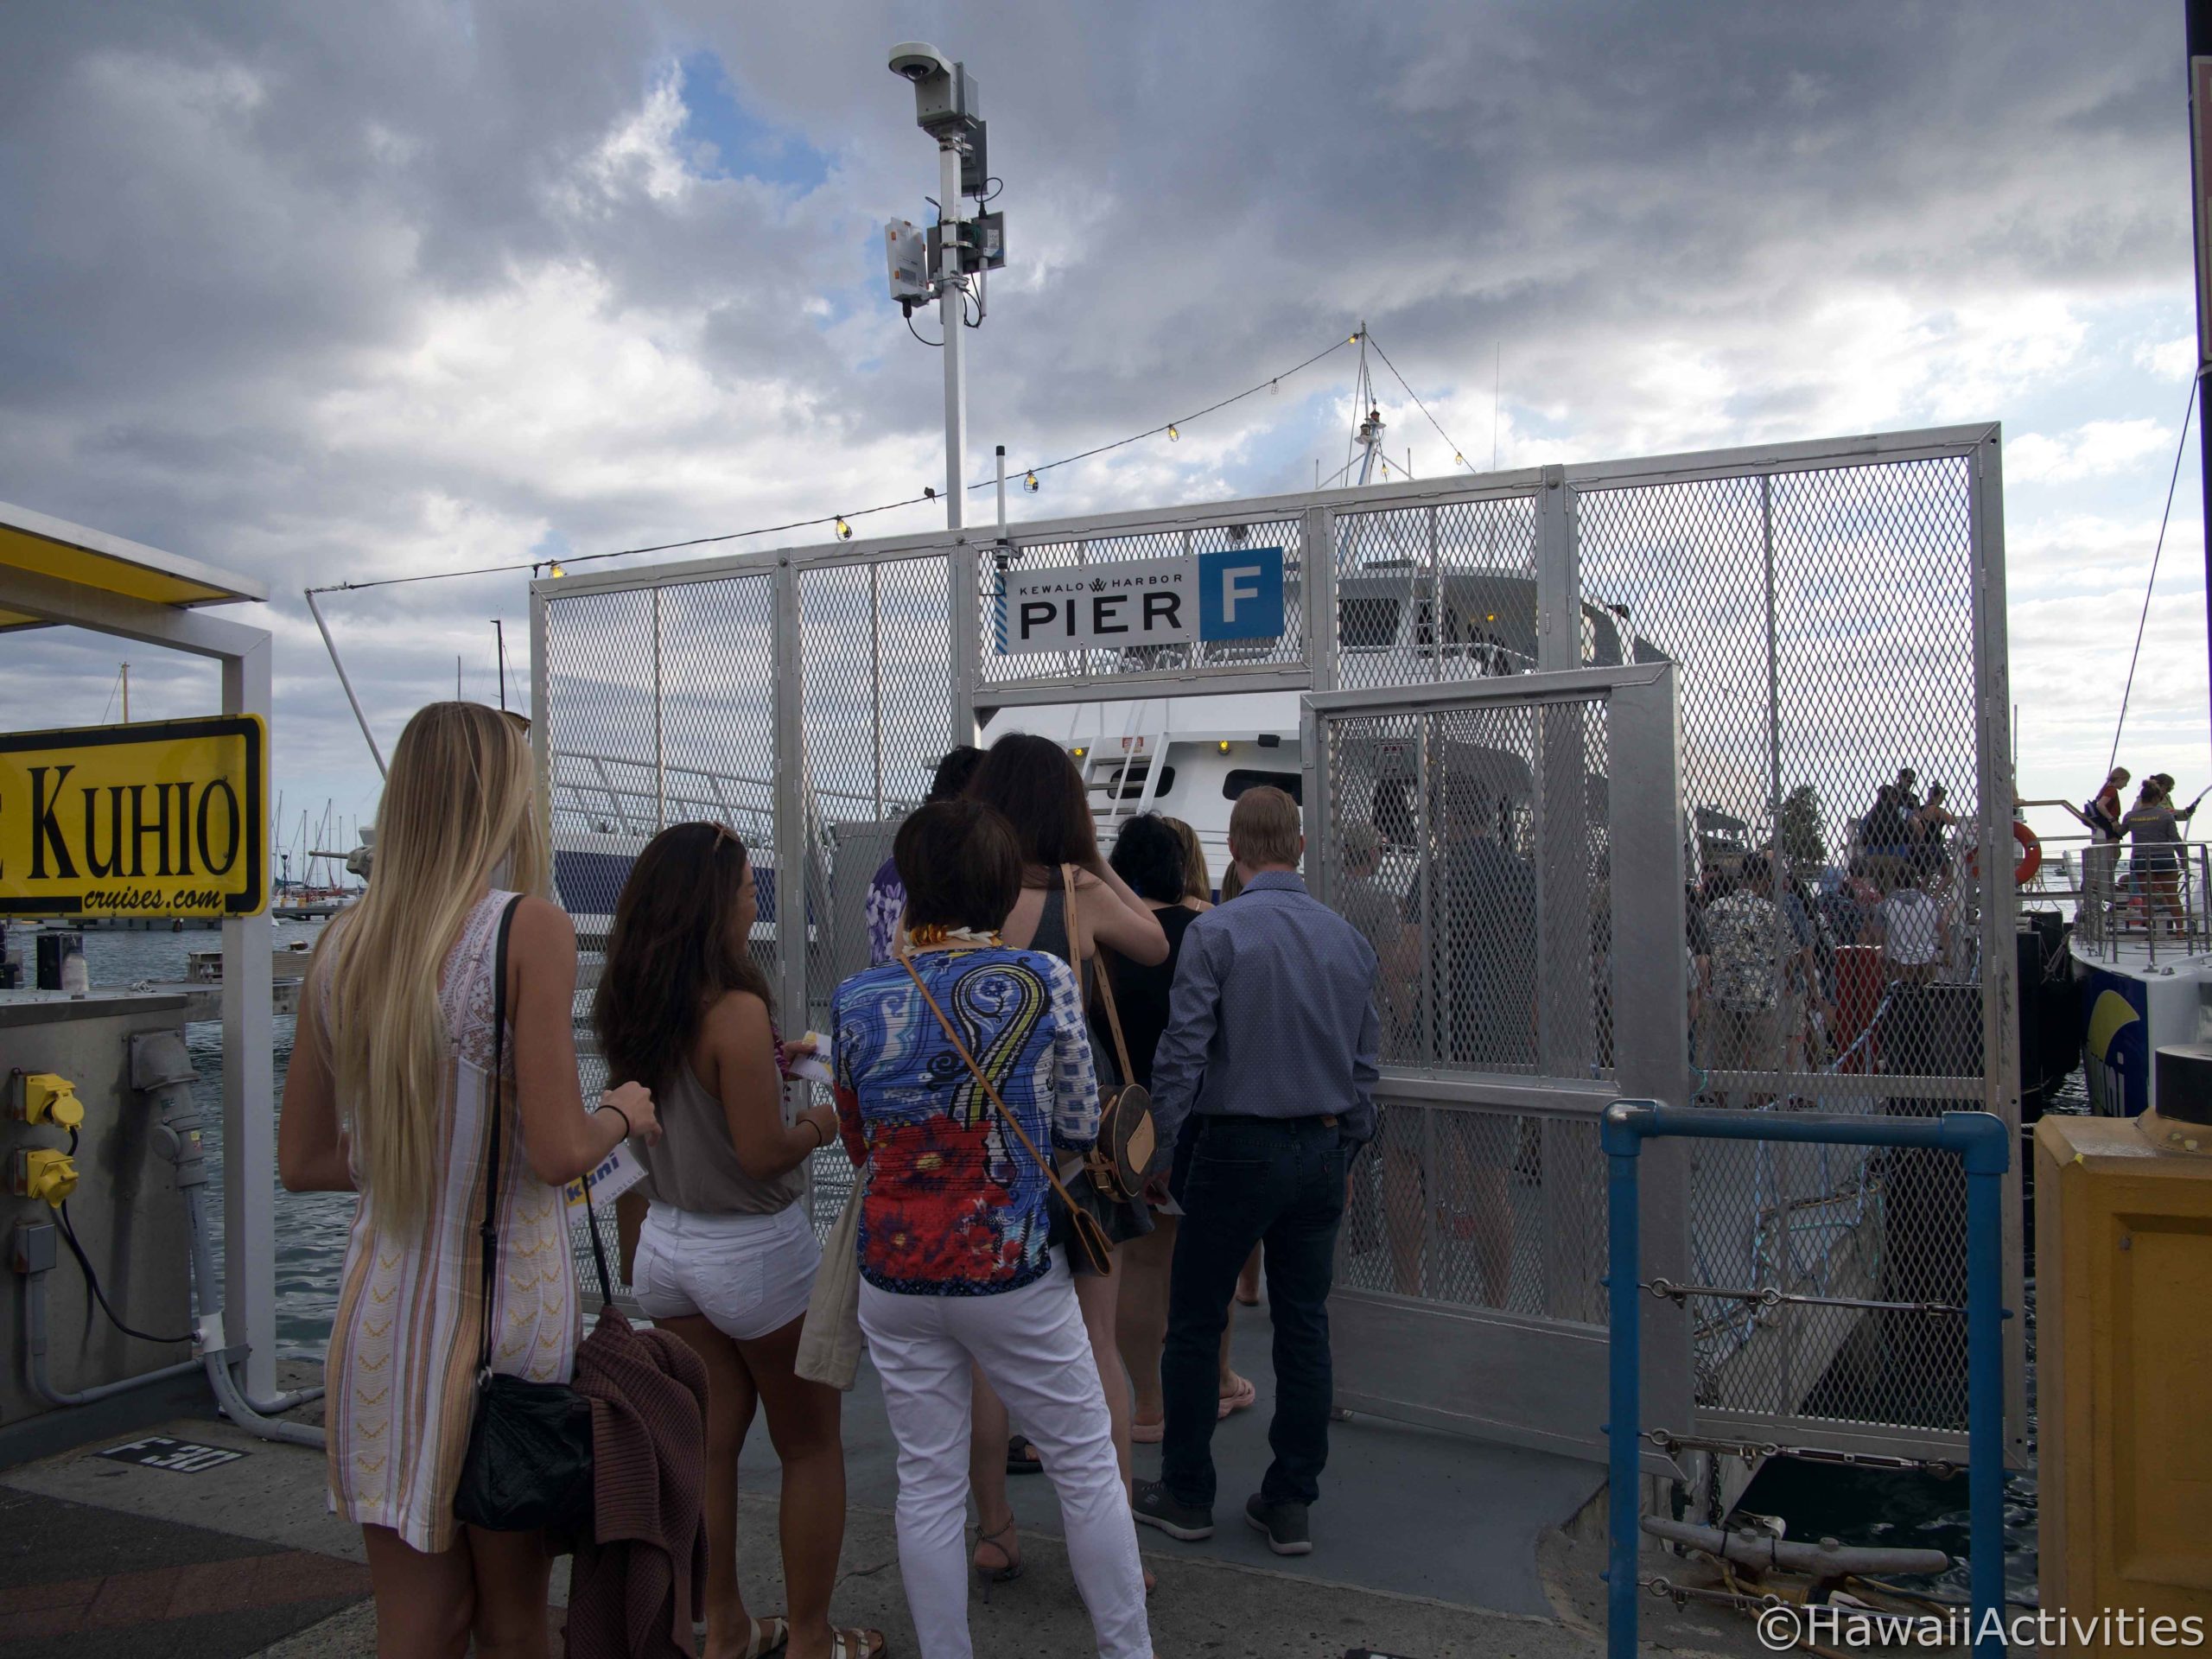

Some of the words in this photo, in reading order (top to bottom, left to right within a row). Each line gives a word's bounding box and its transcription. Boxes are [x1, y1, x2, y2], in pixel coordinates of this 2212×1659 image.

[1020, 582, 1084, 595] KEWALO
[1112, 574, 1182, 588] HARBOR
[1020, 591, 1182, 639] PIER
[1222, 566, 1261, 623] F
[27, 765, 240, 879] KUHIO
[84, 886, 222, 910] cruises.com
